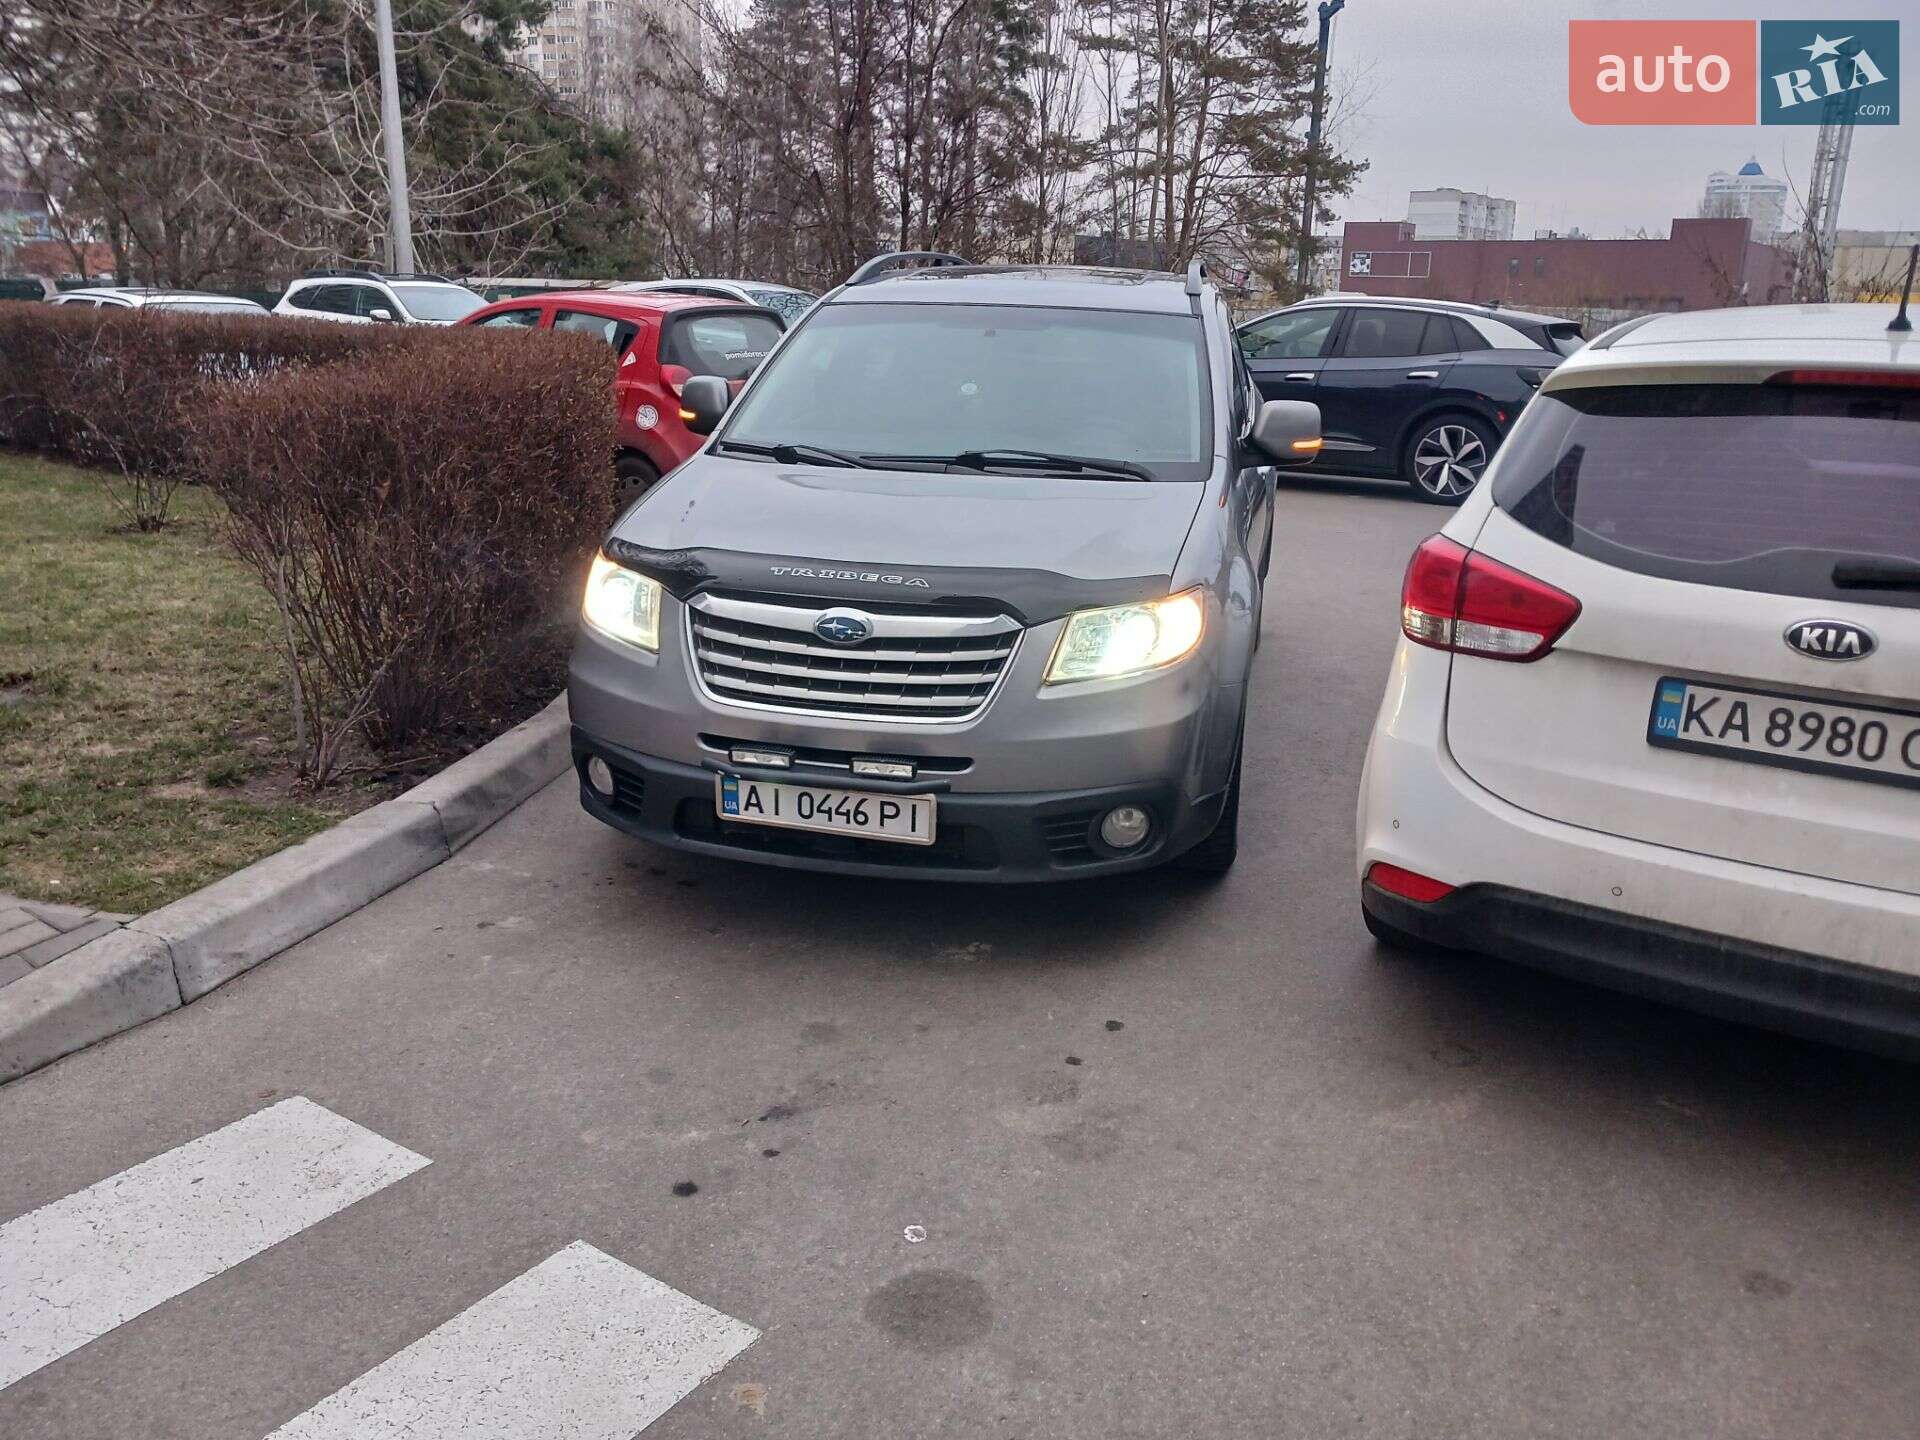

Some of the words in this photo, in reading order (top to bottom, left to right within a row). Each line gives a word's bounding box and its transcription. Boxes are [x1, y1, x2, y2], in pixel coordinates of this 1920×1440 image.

[770, 566, 930, 588] TRIBECA
[1801, 627, 1861, 654] KIA
[1657, 716, 1677, 730] UA
[1682, 693, 1750, 743] KA
[1765, 707, 1888, 762] 8980
[724, 800, 738, 811] UA
[743, 784, 780, 816] AI
[797, 791, 869, 826] 0446
[879, 800, 917, 833] PI
